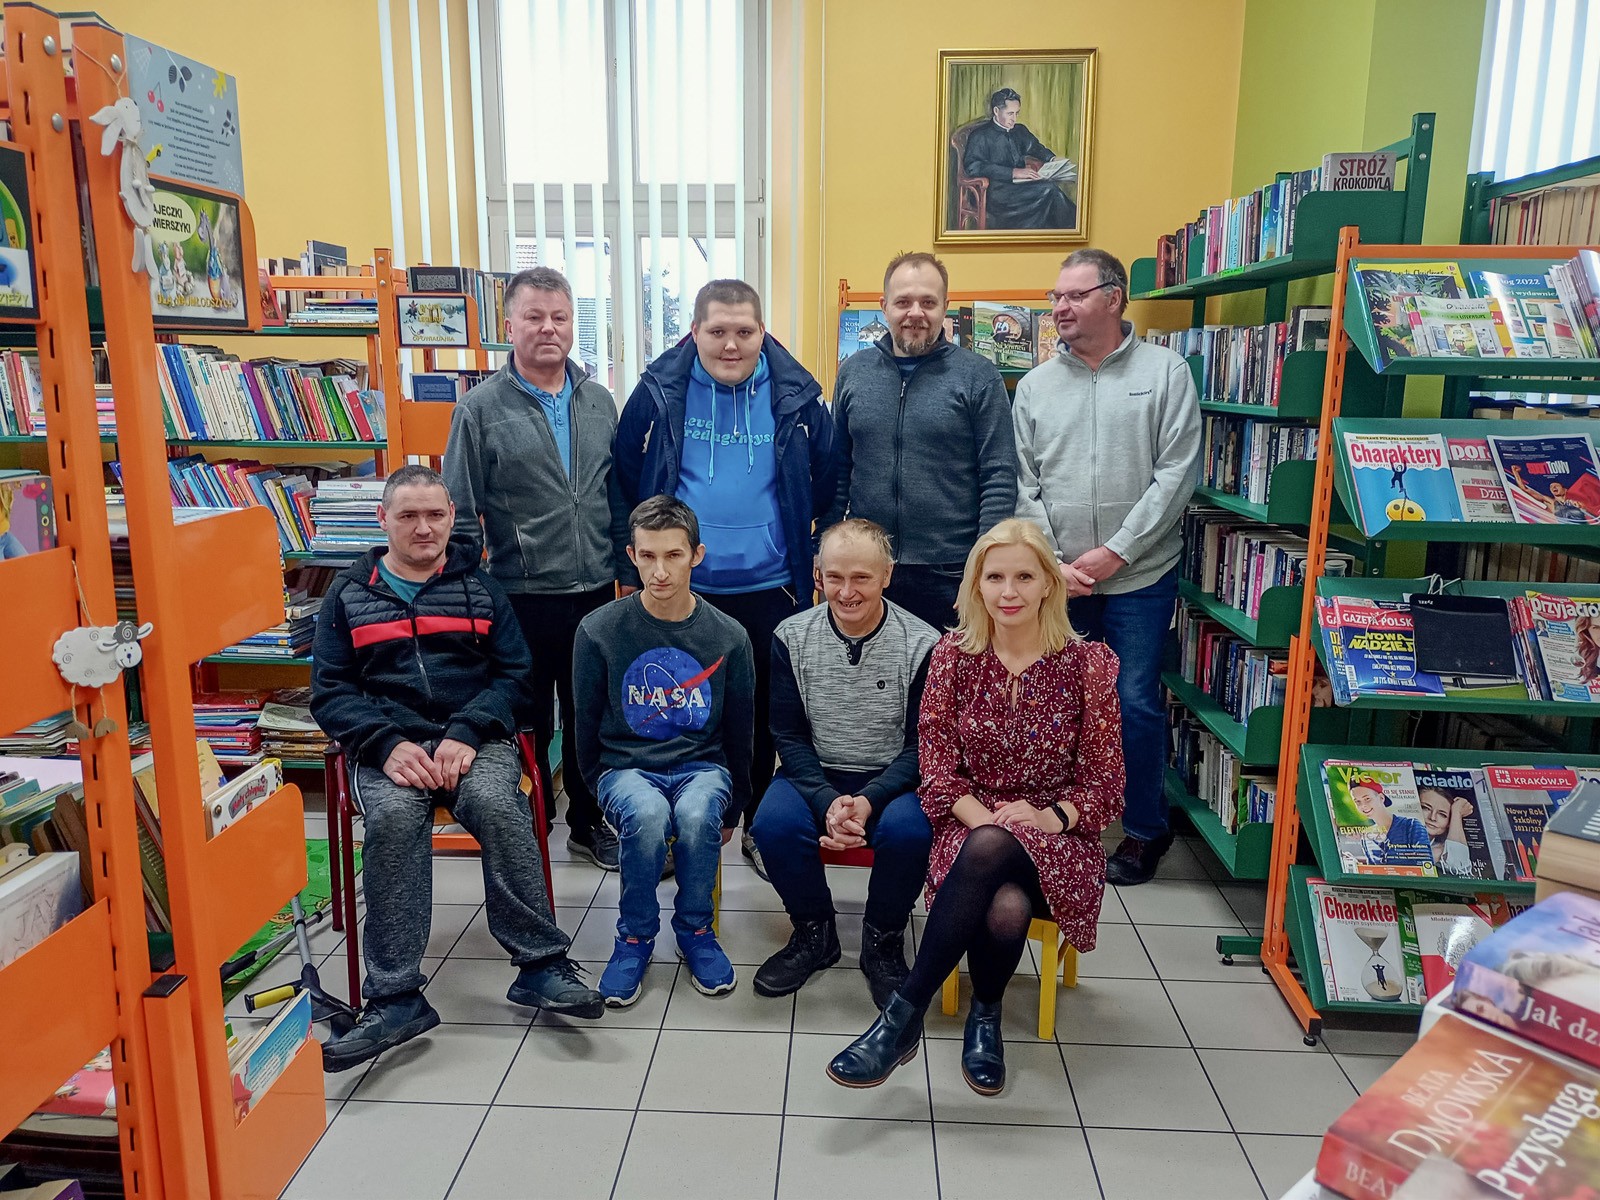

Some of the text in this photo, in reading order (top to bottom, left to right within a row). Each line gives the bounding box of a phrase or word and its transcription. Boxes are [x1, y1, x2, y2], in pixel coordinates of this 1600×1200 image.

[1339, 155, 1387, 176] STRÓŻ
[1333, 177, 1391, 191] KROKODYLA
[1480, 274, 1514, 286] Klog
[1351, 444, 1441, 466] Charaktery
[1343, 613, 1414, 627] GAZETA POLSK
[1348, 639, 1414, 652] NADZIEJ
[628, 685, 706, 708] NASA
[1337, 767, 1402, 784] Victor
[1513, 776, 1571, 786] KRAKÓW.PL
[1506, 807, 1544, 816] Nowy Rok
[1513, 816, 1542, 825] Szkolny
[1521, 996, 1564, 1030] Jak
[1401, 1068, 1454, 1109] BEATA
[1387, 1049, 1523, 1160] DMOWSKA
[1476, 1082, 1600, 1200] Przysługa
